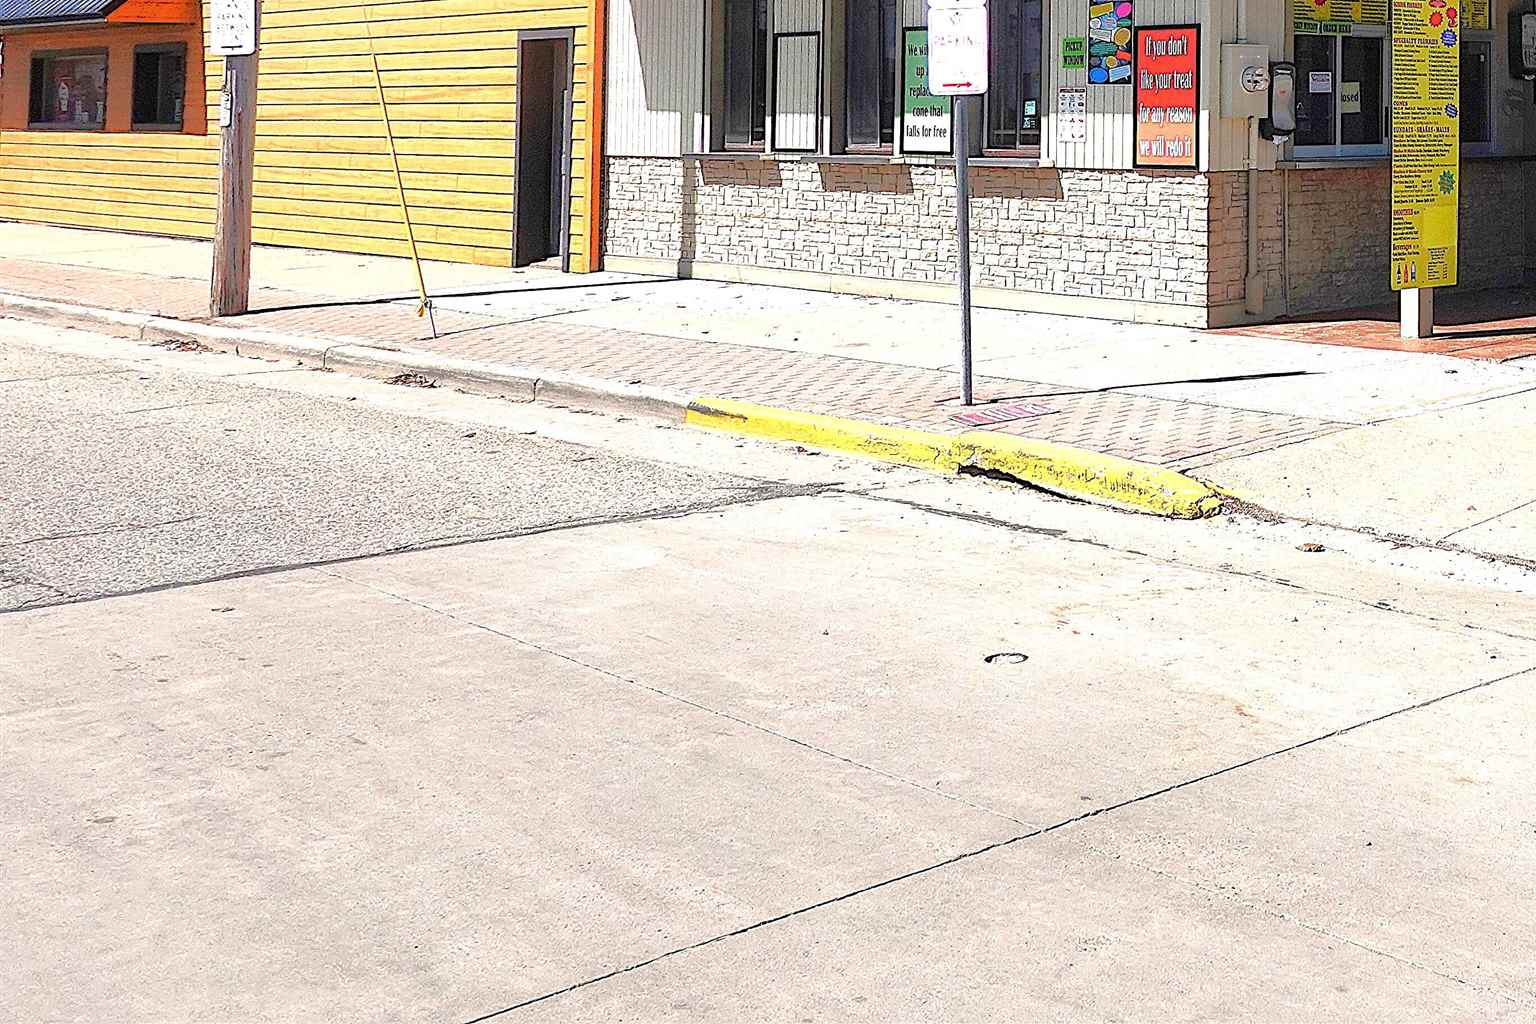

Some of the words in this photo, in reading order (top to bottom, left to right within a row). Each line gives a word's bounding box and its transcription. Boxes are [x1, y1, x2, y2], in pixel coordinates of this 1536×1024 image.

[1145, 35, 1152, 56] If
[1152, 40, 1166, 61] you
[1167, 35, 1187, 56] don't
[915, 65, 925, 79] up
[1140, 69, 1154, 89] like
[1154, 73, 1172, 94] your
[1173, 69, 1193, 89] treat
[912, 106, 929, 117] cone
[929, 104, 944, 118] that
[1139, 102, 1150, 123] for
[1150, 106, 1165, 128] any
[1166, 106, 1193, 124] reason
[906, 124, 920, 138] falls
[921, 124, 932, 138] for
[933, 124, 948, 138] free
[1139, 139, 1150, 157] we
[1151, 135, 1165, 157] will
[1165, 135, 1183, 157] redo
[1184, 135, 1192, 157] it
